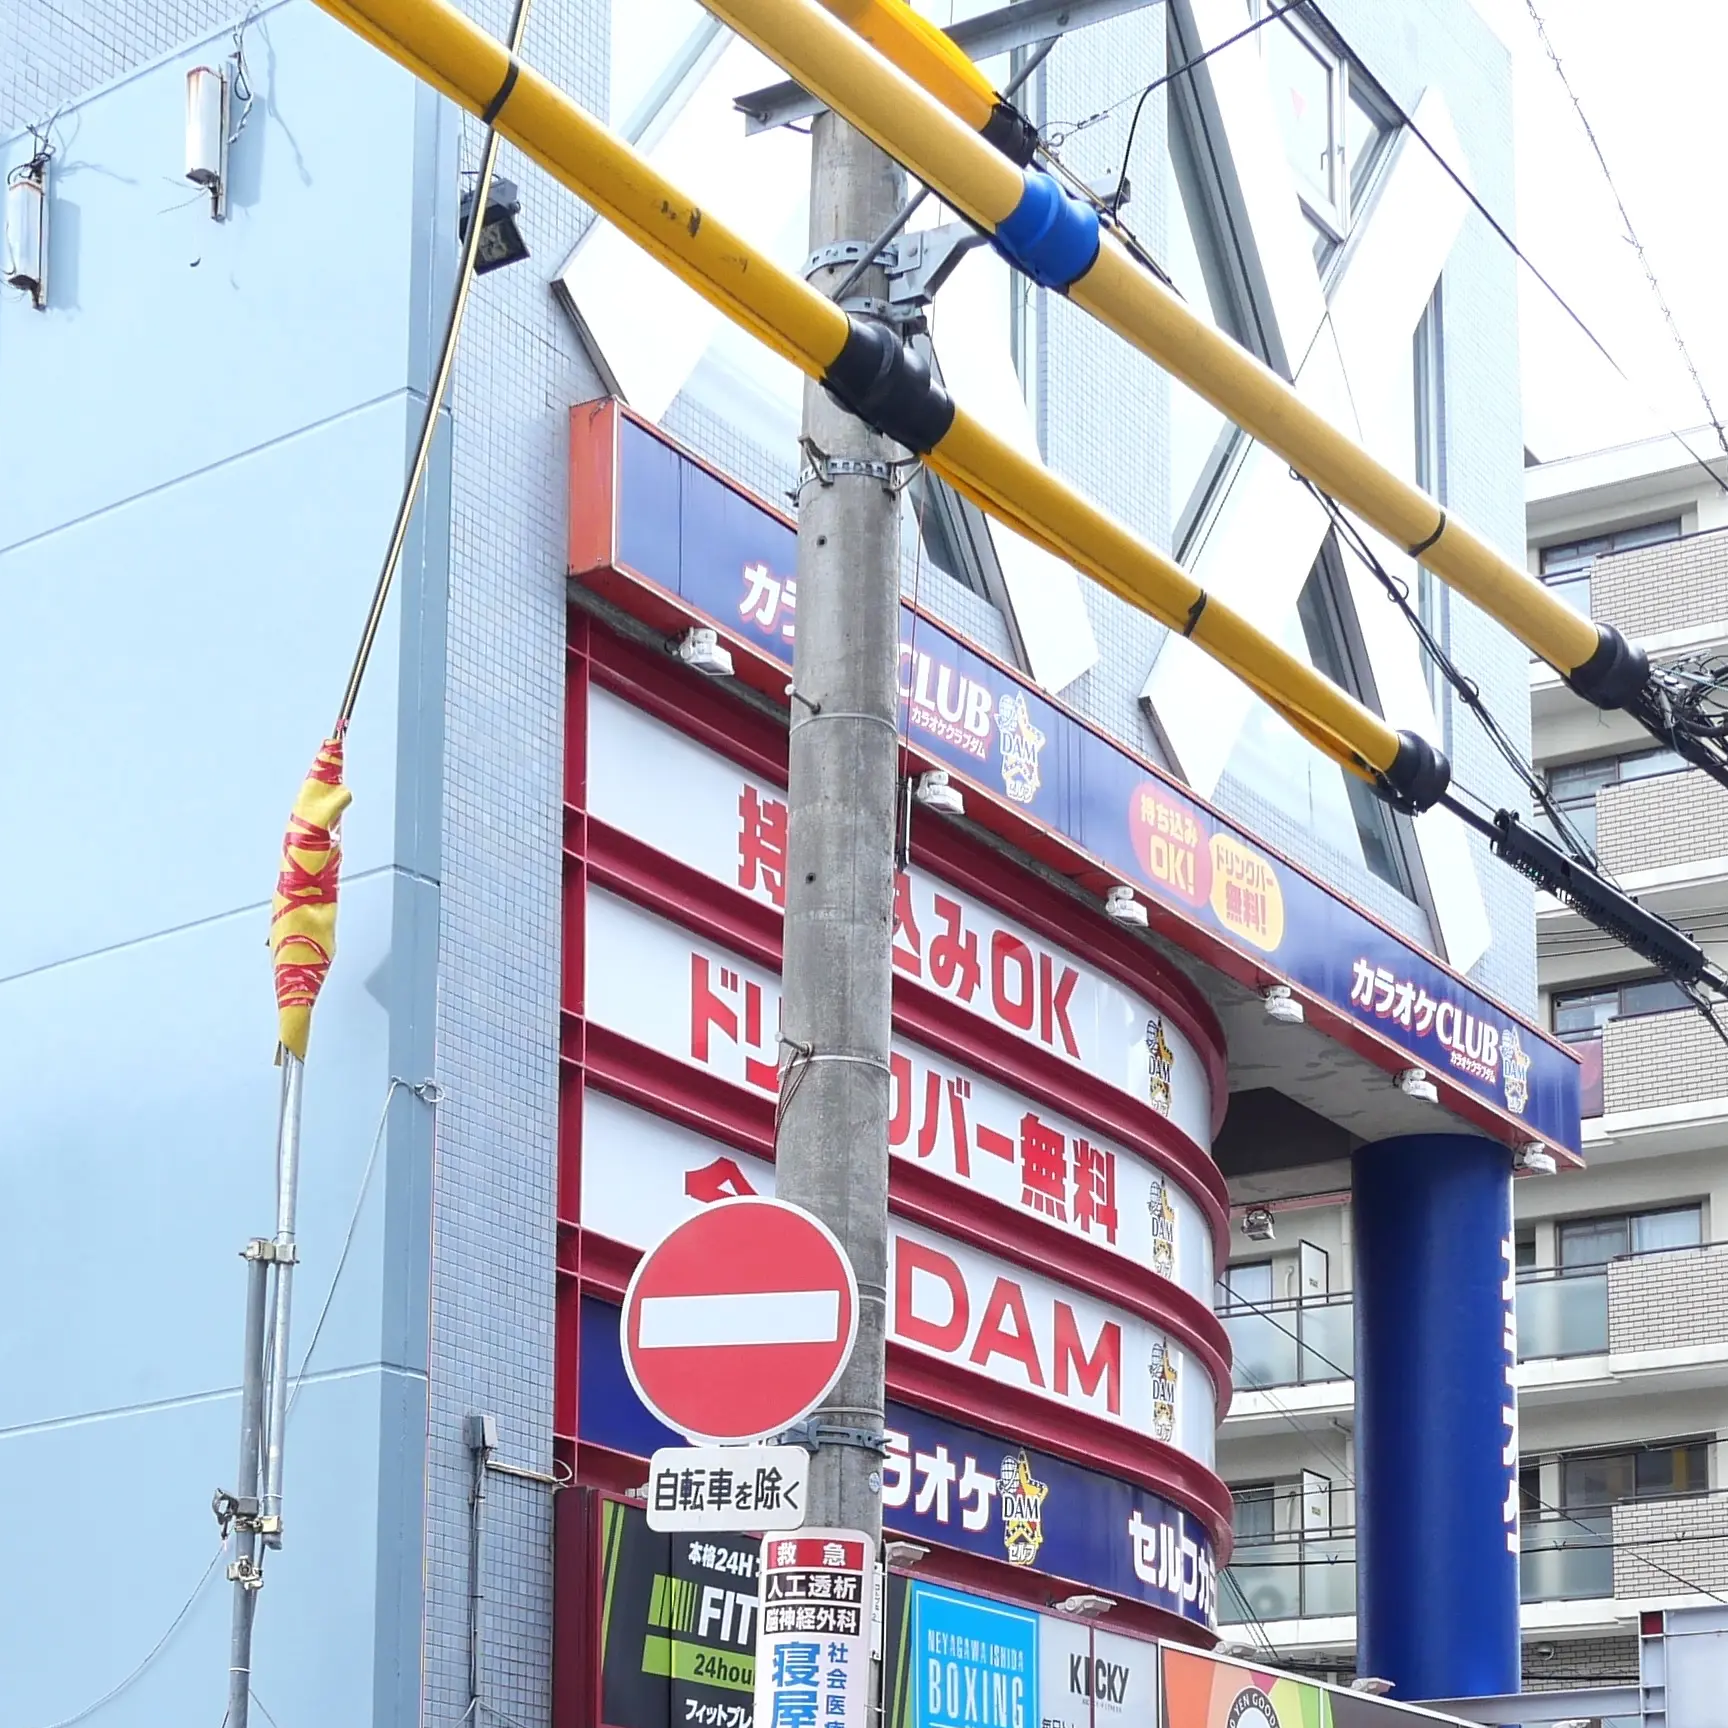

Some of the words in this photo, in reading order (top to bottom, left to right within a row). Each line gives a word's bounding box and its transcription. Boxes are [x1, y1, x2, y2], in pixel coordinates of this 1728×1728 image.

[999, 731, 1039, 763] DAM
[1140, 793, 1200, 848] 持ち込み
[1351, 959, 1501, 1068] カラオケCLUB
[1148, 1056, 1171, 1084] DAM
[1151, 1216, 1173, 1243] DAM
[894, 1234, 1122, 1417] DAM
[1152, 1378, 1175, 1404] DAM
[653, 1466, 800, 1512] 自転車を除く
[1003, 1493, 1040, 1521] DAM
[776, 1542, 846, 1567] 救急
[767, 1575, 857, 1601] 人工透析
[765, 1606, 857, 1634] 脳神経外科
[927, 1629, 987, 1665] NEYAGAWA
[990, 1644, 1024, 1673] ISHIDA
[694, 1653, 756, 1686] 24hou
[1233, 1695, 1251, 1716] YEN
